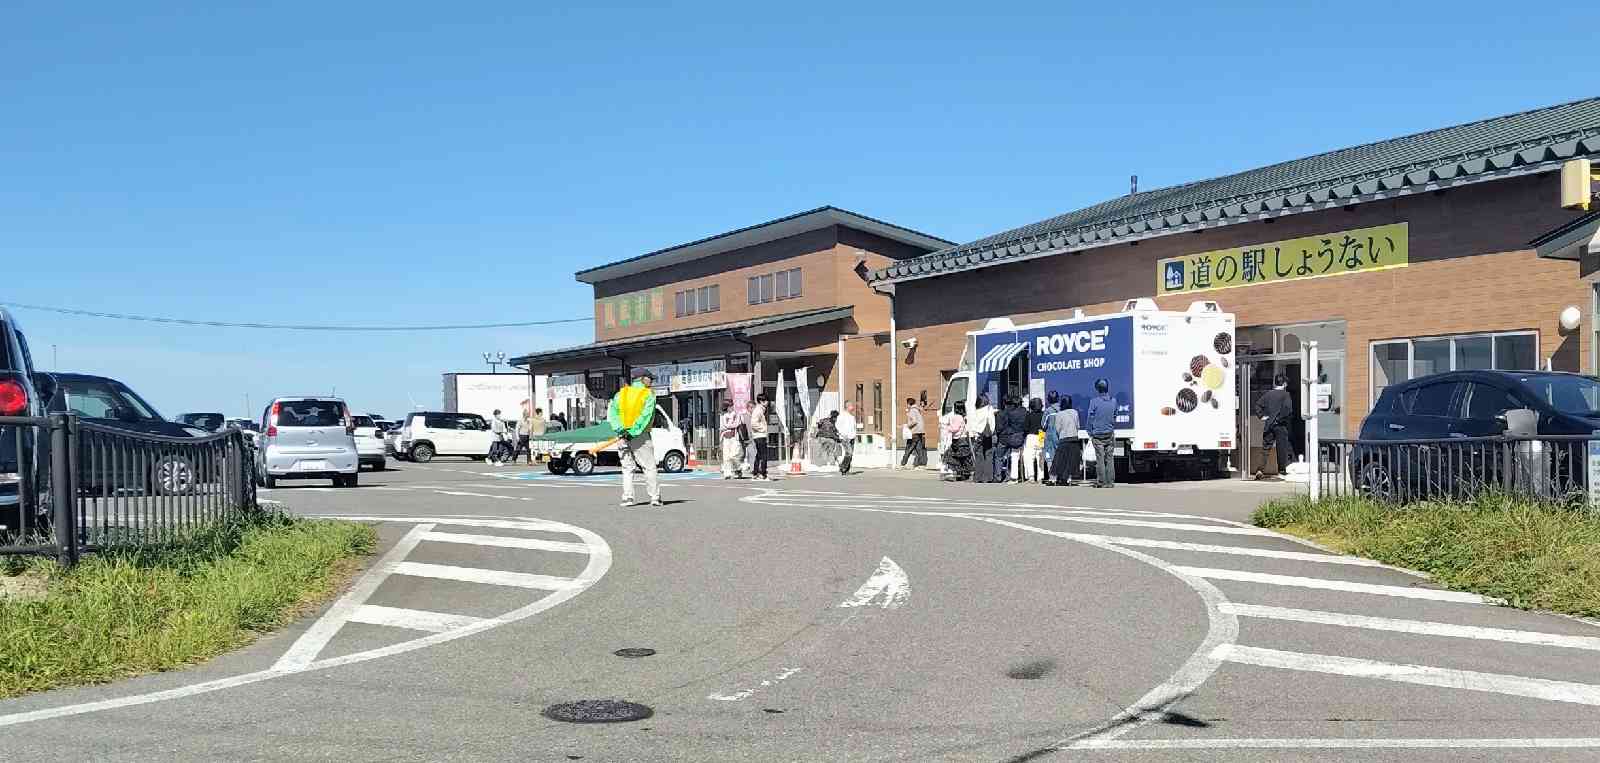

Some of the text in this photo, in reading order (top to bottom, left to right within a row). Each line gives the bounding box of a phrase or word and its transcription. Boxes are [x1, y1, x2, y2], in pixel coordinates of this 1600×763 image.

[1189, 234, 1395, 289] 道の駅しょうない
[1036, 325, 1109, 356] ROYCE'
[1037, 358, 1105, 372] CHOCOLATE SHOP
